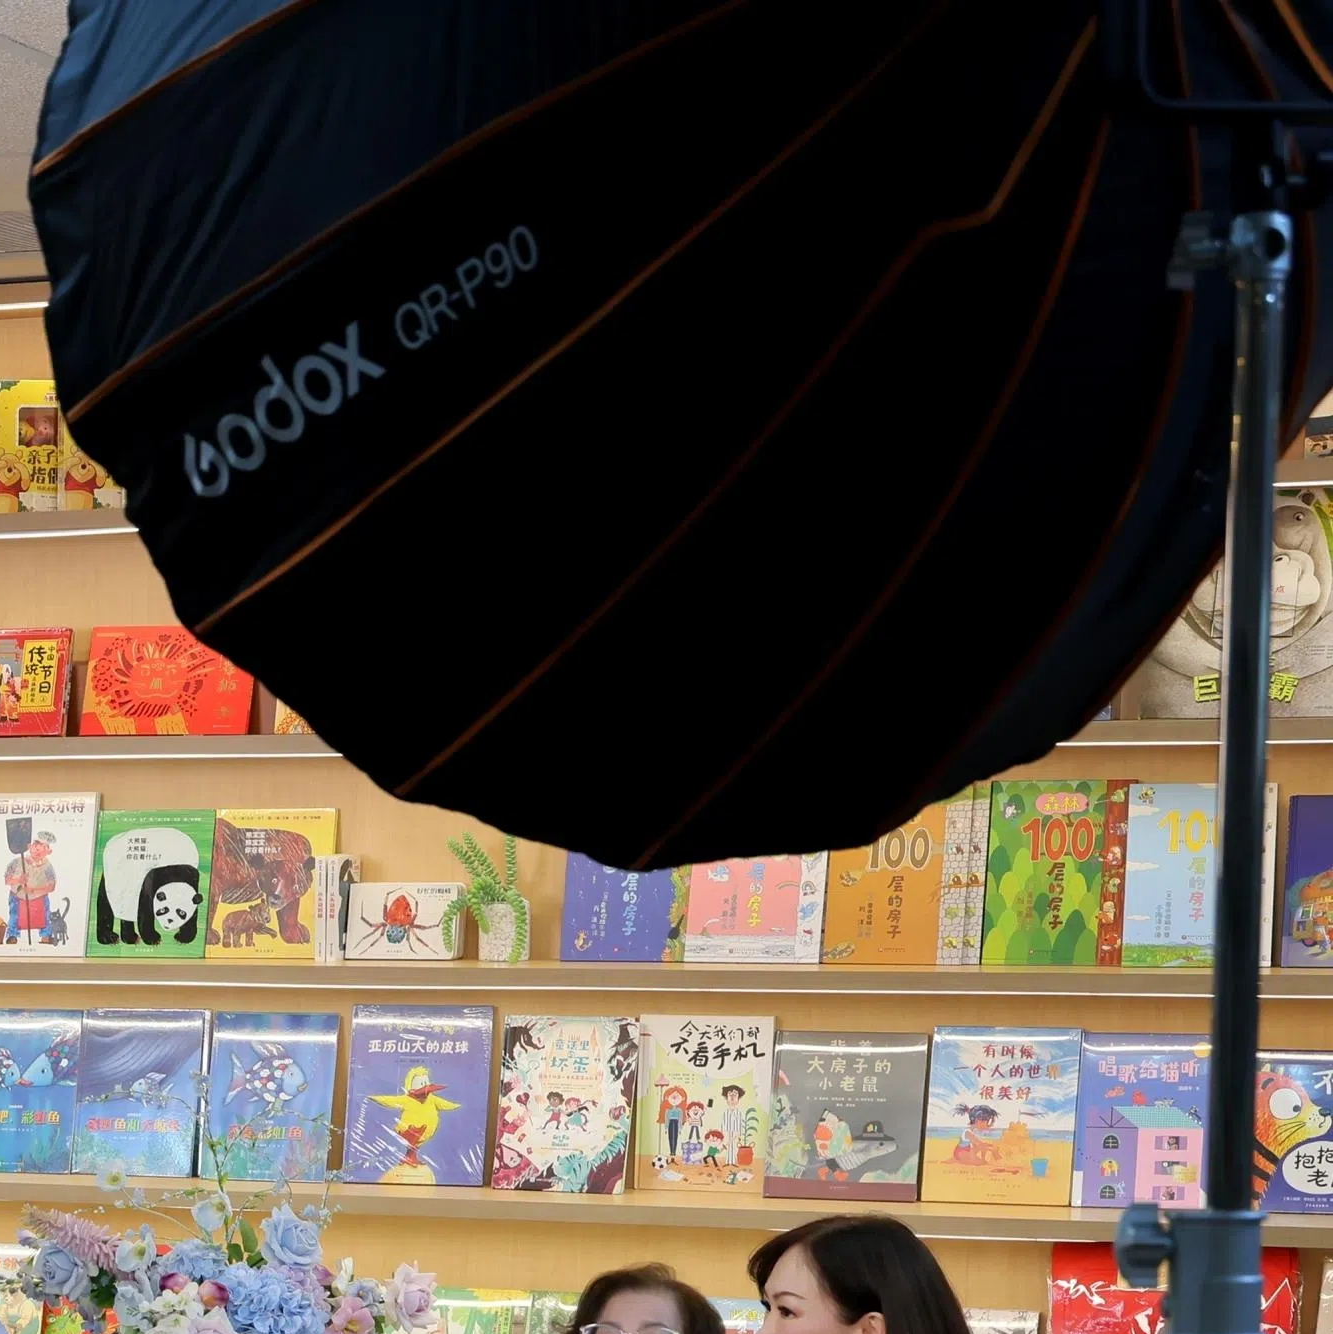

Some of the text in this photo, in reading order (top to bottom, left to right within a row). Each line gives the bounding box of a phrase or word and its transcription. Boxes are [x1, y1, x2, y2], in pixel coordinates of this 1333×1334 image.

[395, 226, 538, 350] QR-P90
[1044, 796, 1080, 811] 森林
[1021, 816, 1096, 863] 100
[1157, 809, 1220, 854] 10
[1046, 862, 1066, 931] 层的房子
[886, 875, 903, 940] 层的房子
[368, 1039, 470, 1054] 亚历山大的皮球
[982, 1044, 1036, 1060] 有时候
[806, 1056, 892, 1075] 大房子的
[953, 1064, 1062, 1081] 一个人的世界
[1098, 1055, 1201, 1084] 唱歌给猫听
[818, 1075, 878, 1093] 小老鼠
[979, 1085, 1032, 1102] 很美好
[1307, 1169, 1333, 1188] 老
